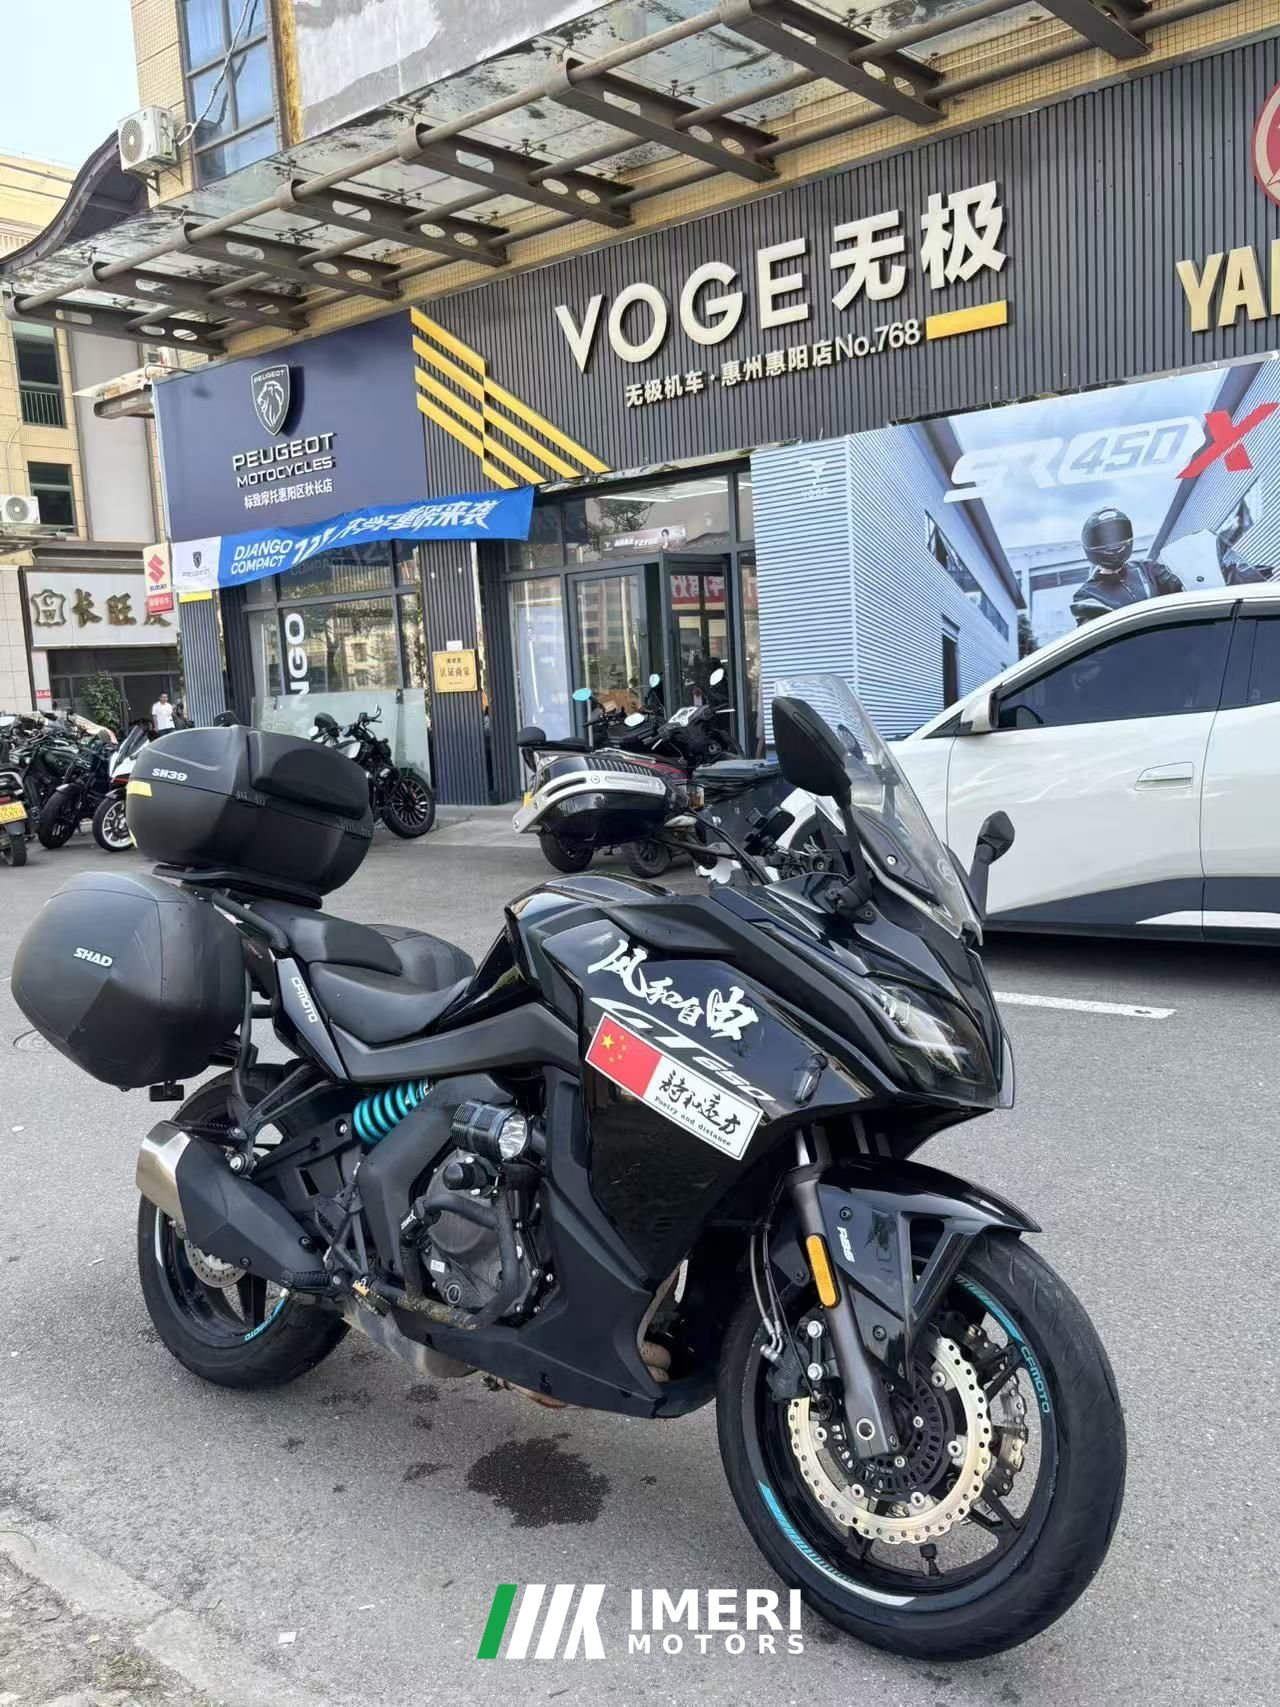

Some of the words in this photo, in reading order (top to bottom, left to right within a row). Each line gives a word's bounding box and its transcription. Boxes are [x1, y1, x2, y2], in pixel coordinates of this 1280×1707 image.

[554, 237, 811, 374] VOGE
[829, 180, 1008, 312] 无极
[1176, 239, 1280, 333] YA
[253, 369, 286, 383] PEUGEOT
[232, 432, 335, 471] PEUGEOT
[236, 456, 333, 488] MOTOCYCLES
[231, 555, 286, 576] COMPACT
[233, 539, 294, 561] DJANGO
[152, 768, 188, 781] SH39
[73, 947, 113, 967] SHAD
[291, 976, 318, 1023] CFMOTO
[654, 1096, 679, 1115] Poetry
[681, 1114, 696, 1126] and
[698, 1124, 732, 1146] distance
[1021, 1346, 1050, 1414] CFMOTO
